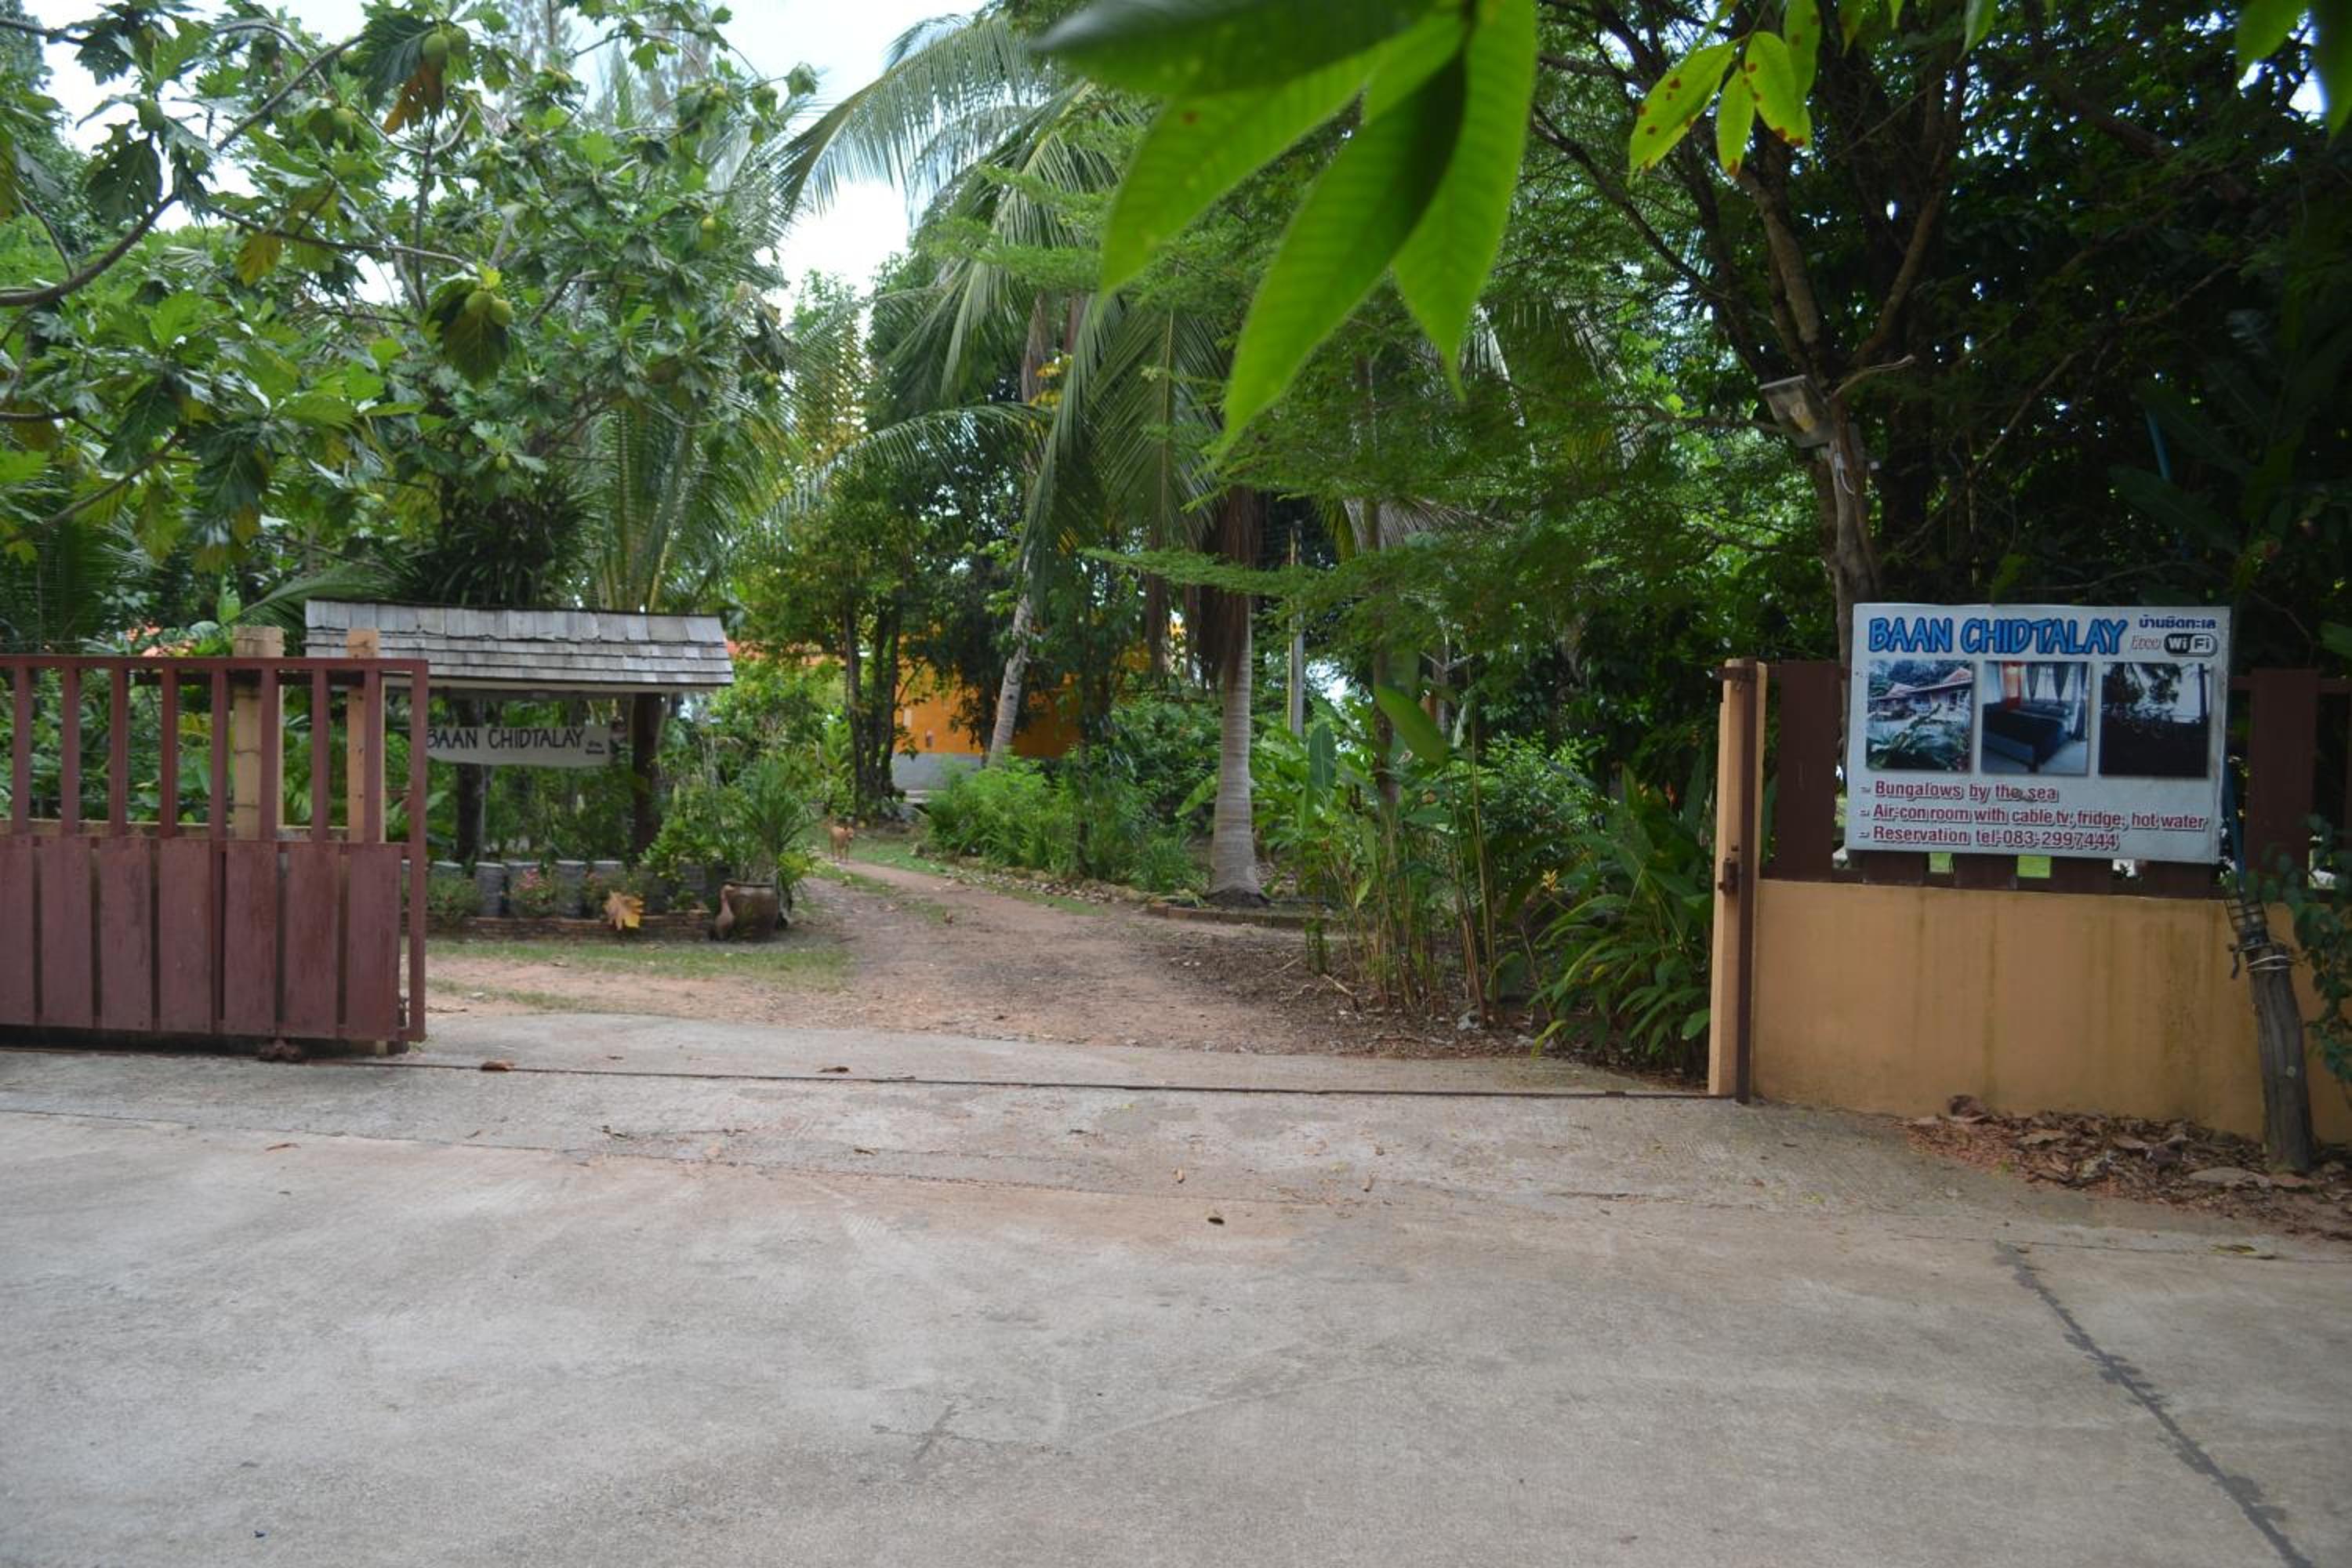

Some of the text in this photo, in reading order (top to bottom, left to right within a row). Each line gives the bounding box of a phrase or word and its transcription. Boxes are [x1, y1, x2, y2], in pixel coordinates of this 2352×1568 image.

[1868, 617, 2129, 655] BAAN CHIDTALAY
[427, 728, 477, 749] BAAN
[488, 728, 585, 749] CHIDTALAY
[1875, 781, 2059, 802] Bungalows by the sea
[1929, 808, 1971, 822] room
[1974, 808, 2008, 824] with
[2012, 809, 2053, 826] cable
[2132, 812, 2158, 829] hot
[2160, 815, 2207, 832] water
[1873, 826, 1970, 845] Reservation
